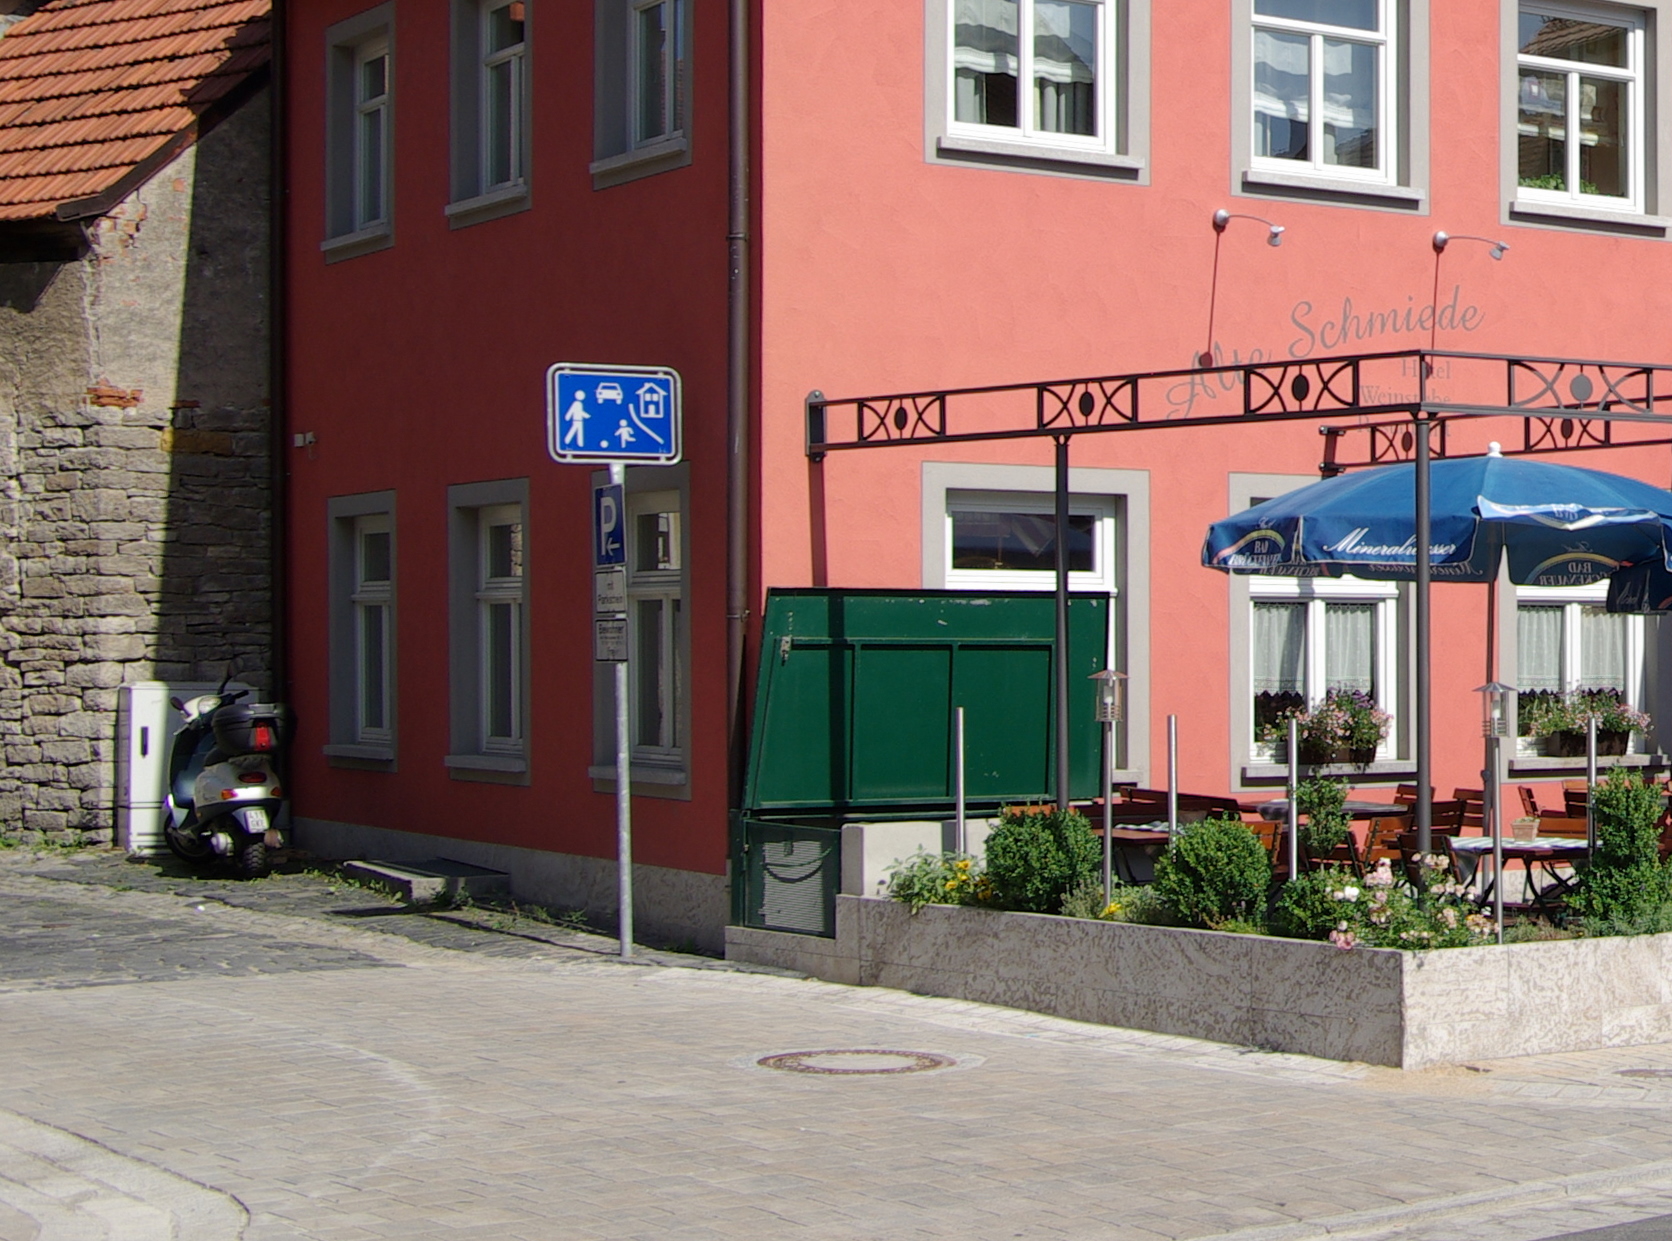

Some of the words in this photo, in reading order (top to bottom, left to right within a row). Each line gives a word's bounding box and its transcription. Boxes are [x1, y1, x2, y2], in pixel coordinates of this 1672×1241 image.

[1288, 285, 1485, 358] Schmiede
[1401, 359, 1451, 379] Htel
[1360, 385, 1451, 405] Weinstbe
[600, 497, 617, 556] P
